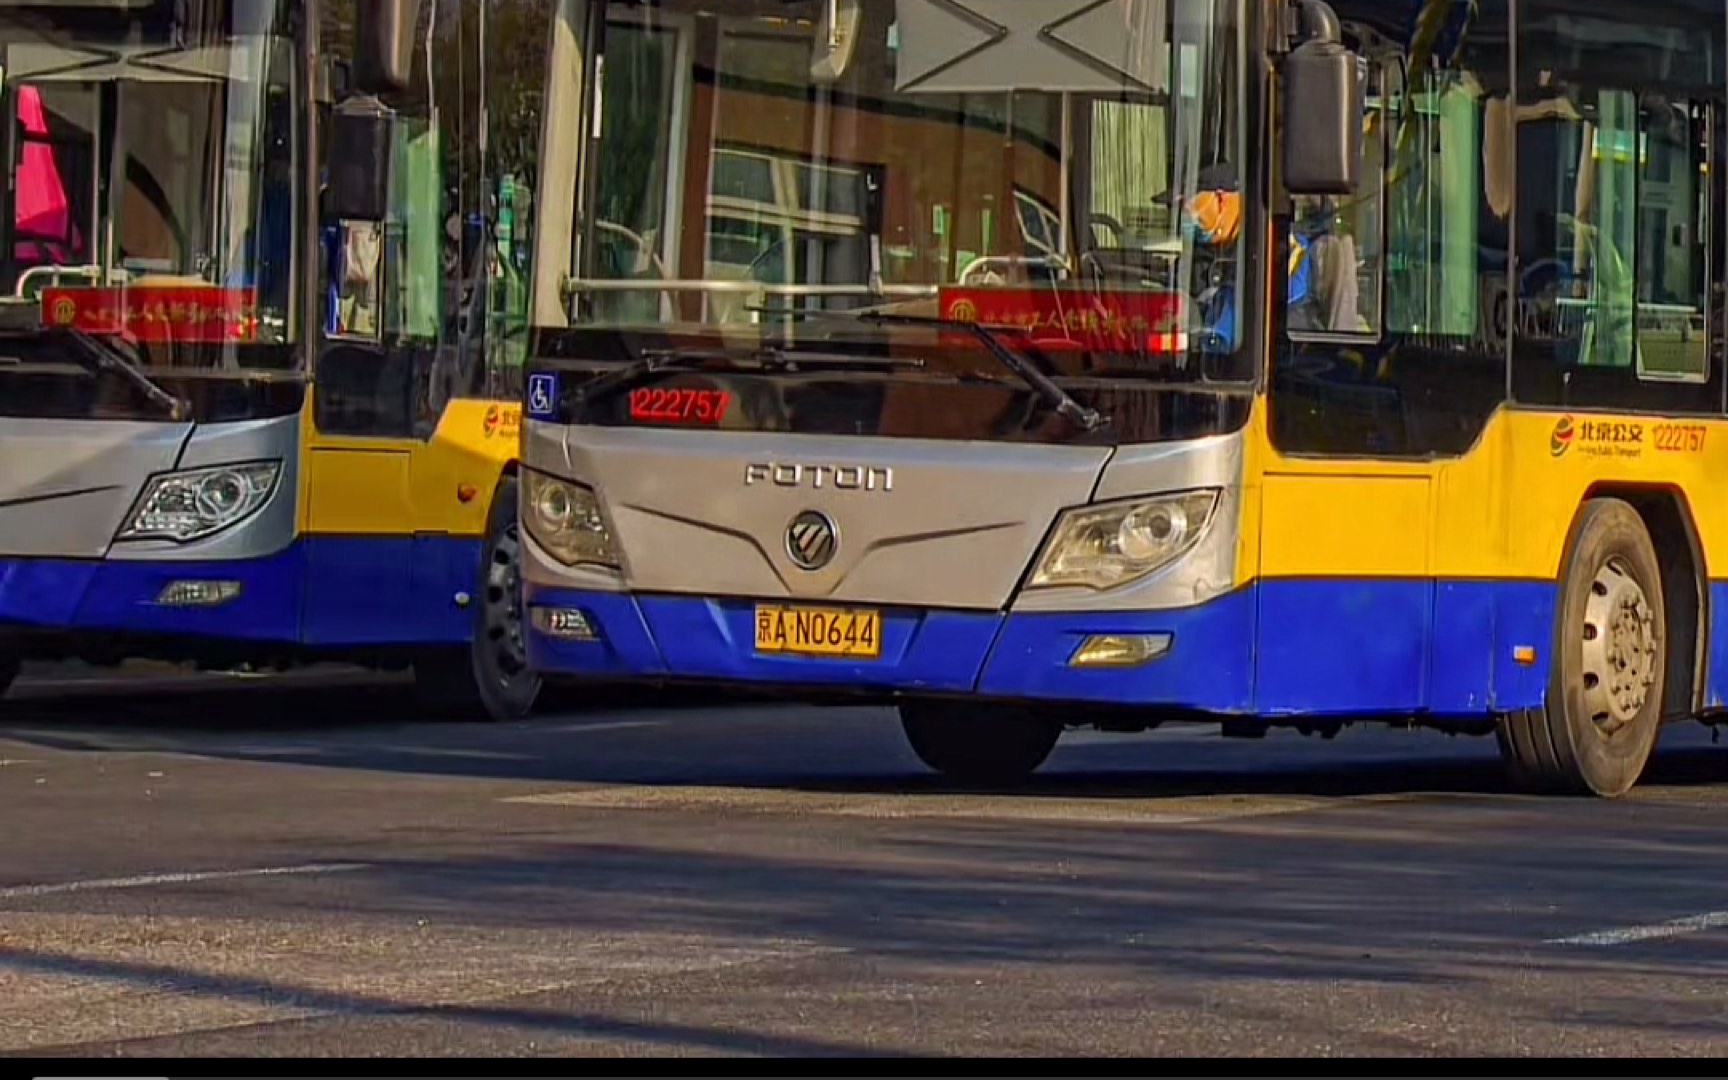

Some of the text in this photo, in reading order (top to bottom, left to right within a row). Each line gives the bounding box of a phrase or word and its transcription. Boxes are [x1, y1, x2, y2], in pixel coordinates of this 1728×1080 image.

[630, 388, 731, 423] 1222757
[1579, 421, 1643, 443] 北京公交
[745, 462, 893, 491] FOTON
